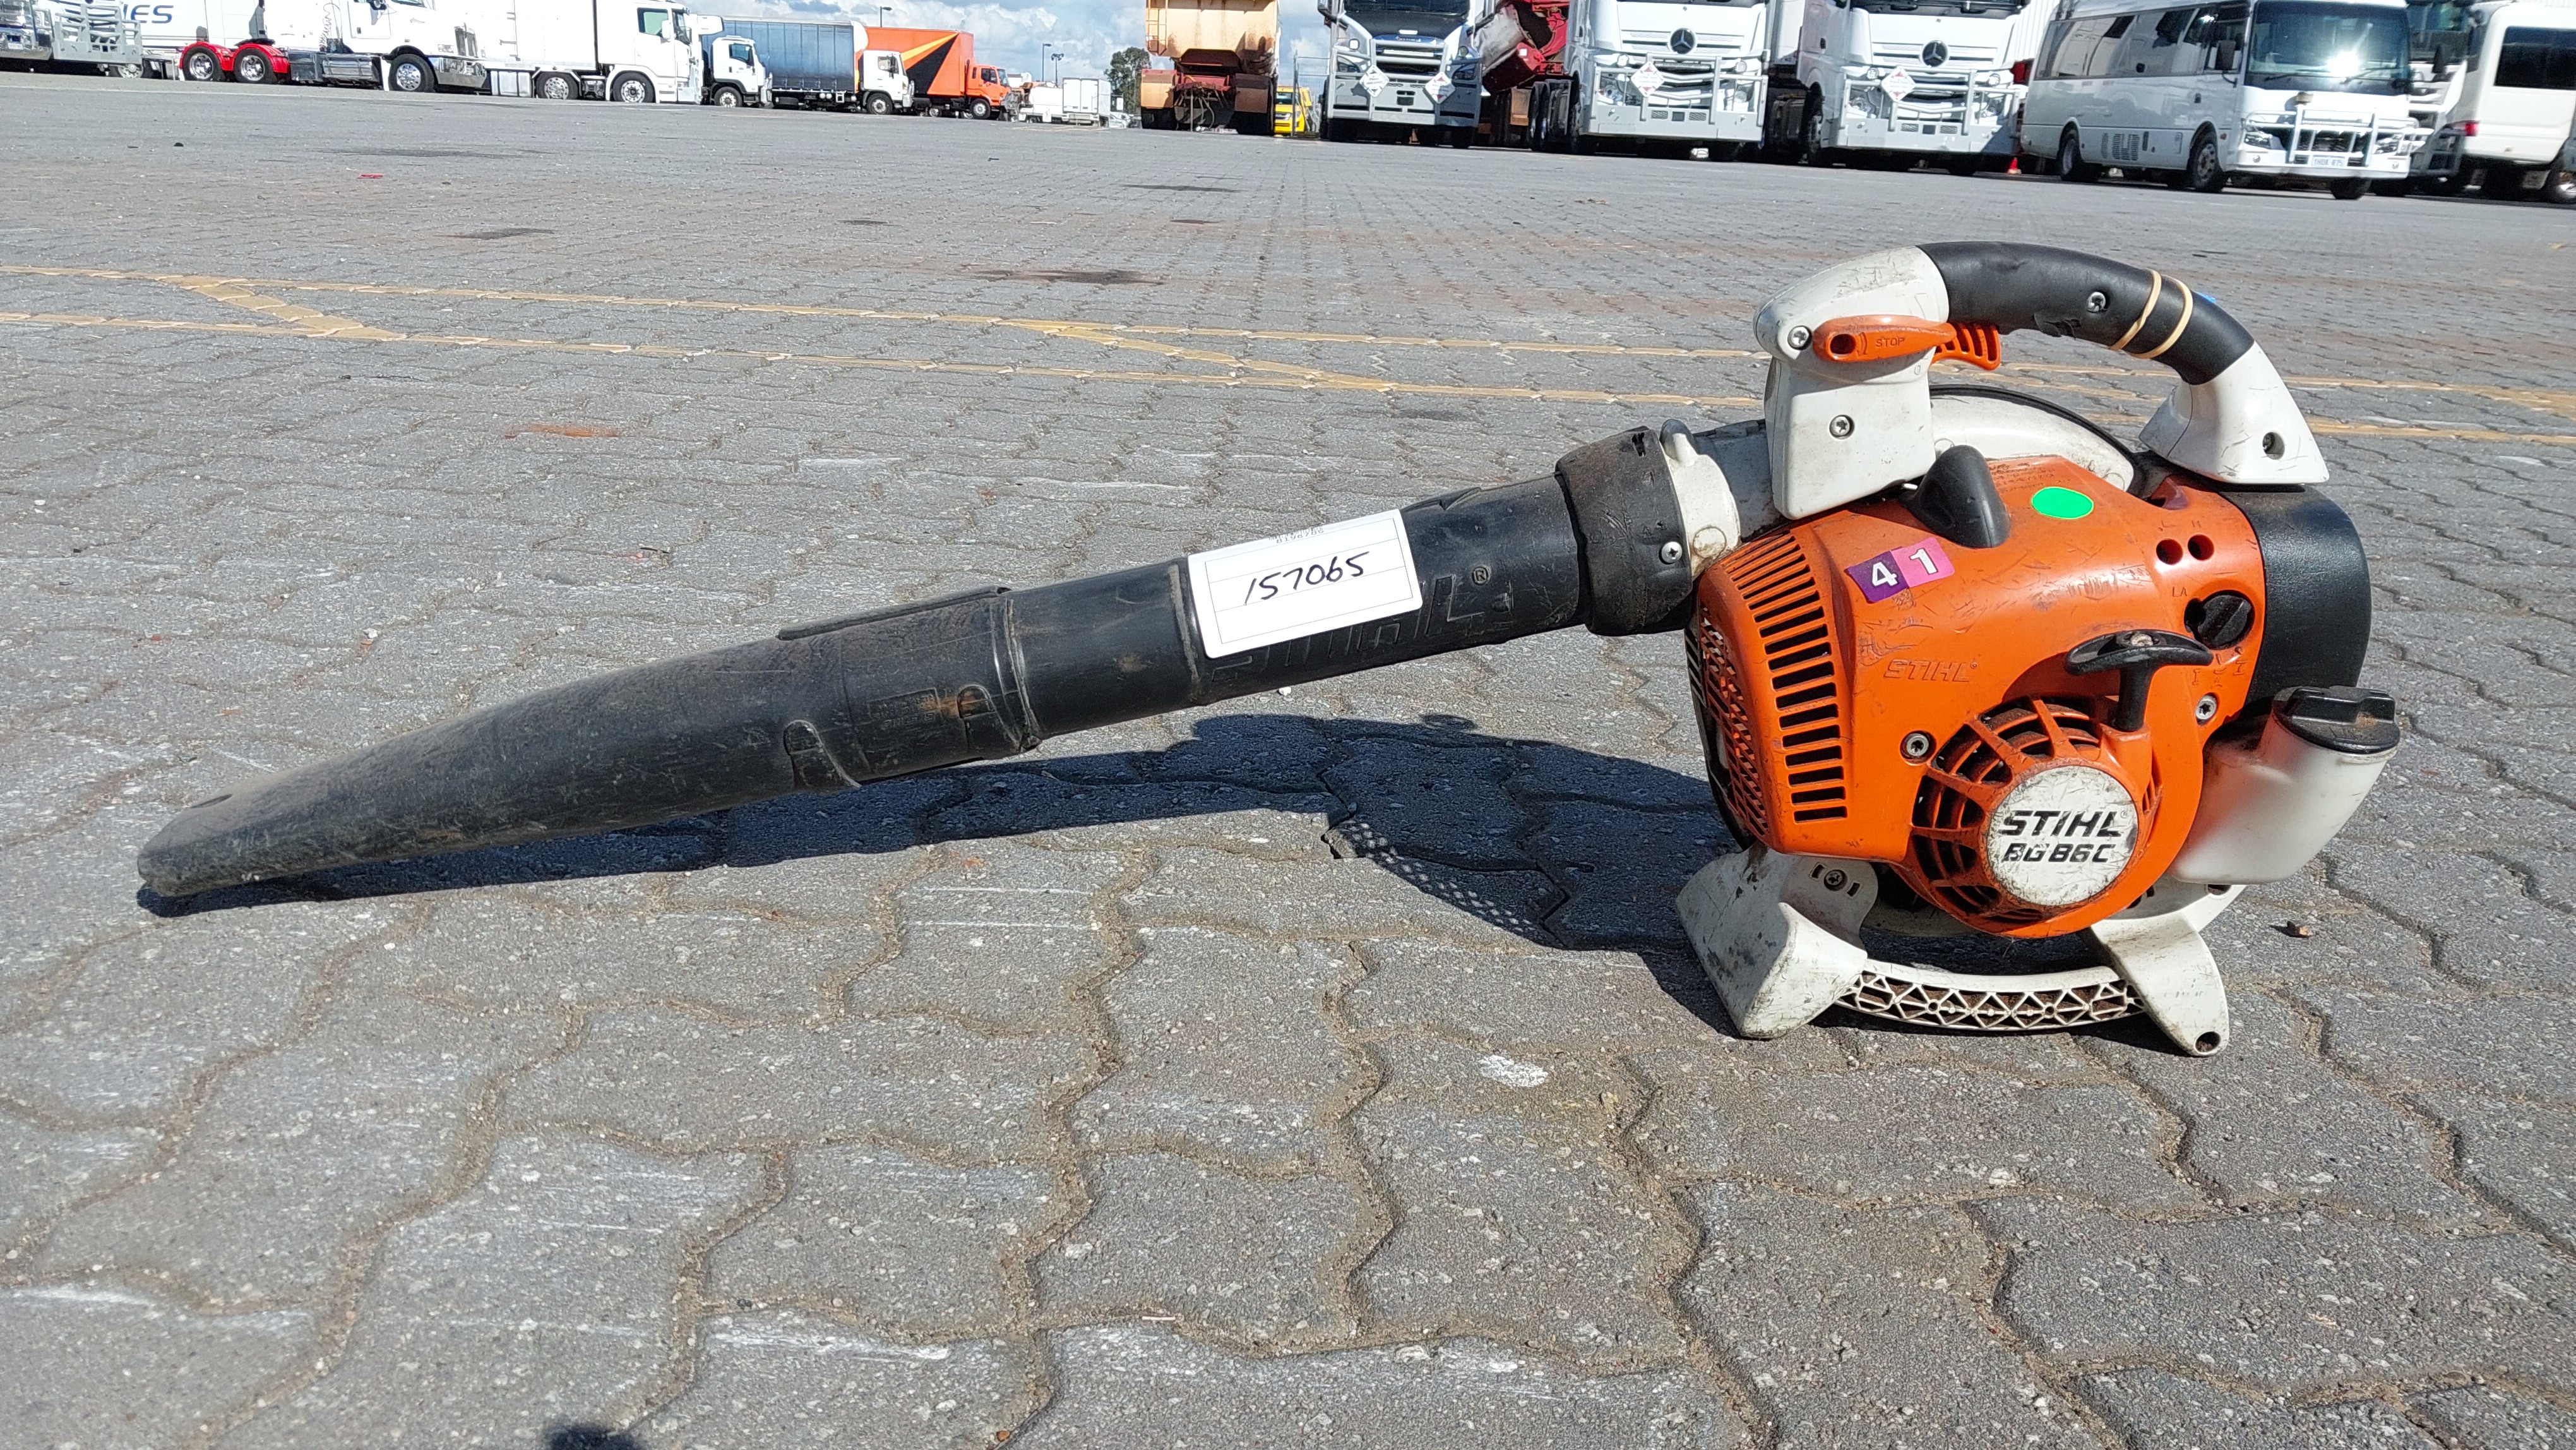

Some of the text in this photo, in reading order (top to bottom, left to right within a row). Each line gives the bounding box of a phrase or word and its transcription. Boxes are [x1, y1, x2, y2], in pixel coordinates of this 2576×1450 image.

[1875, 337, 1905, 348] STOP
[1243, 551, 1370, 606] 157065
[2172, 586, 2188, 597] LA
